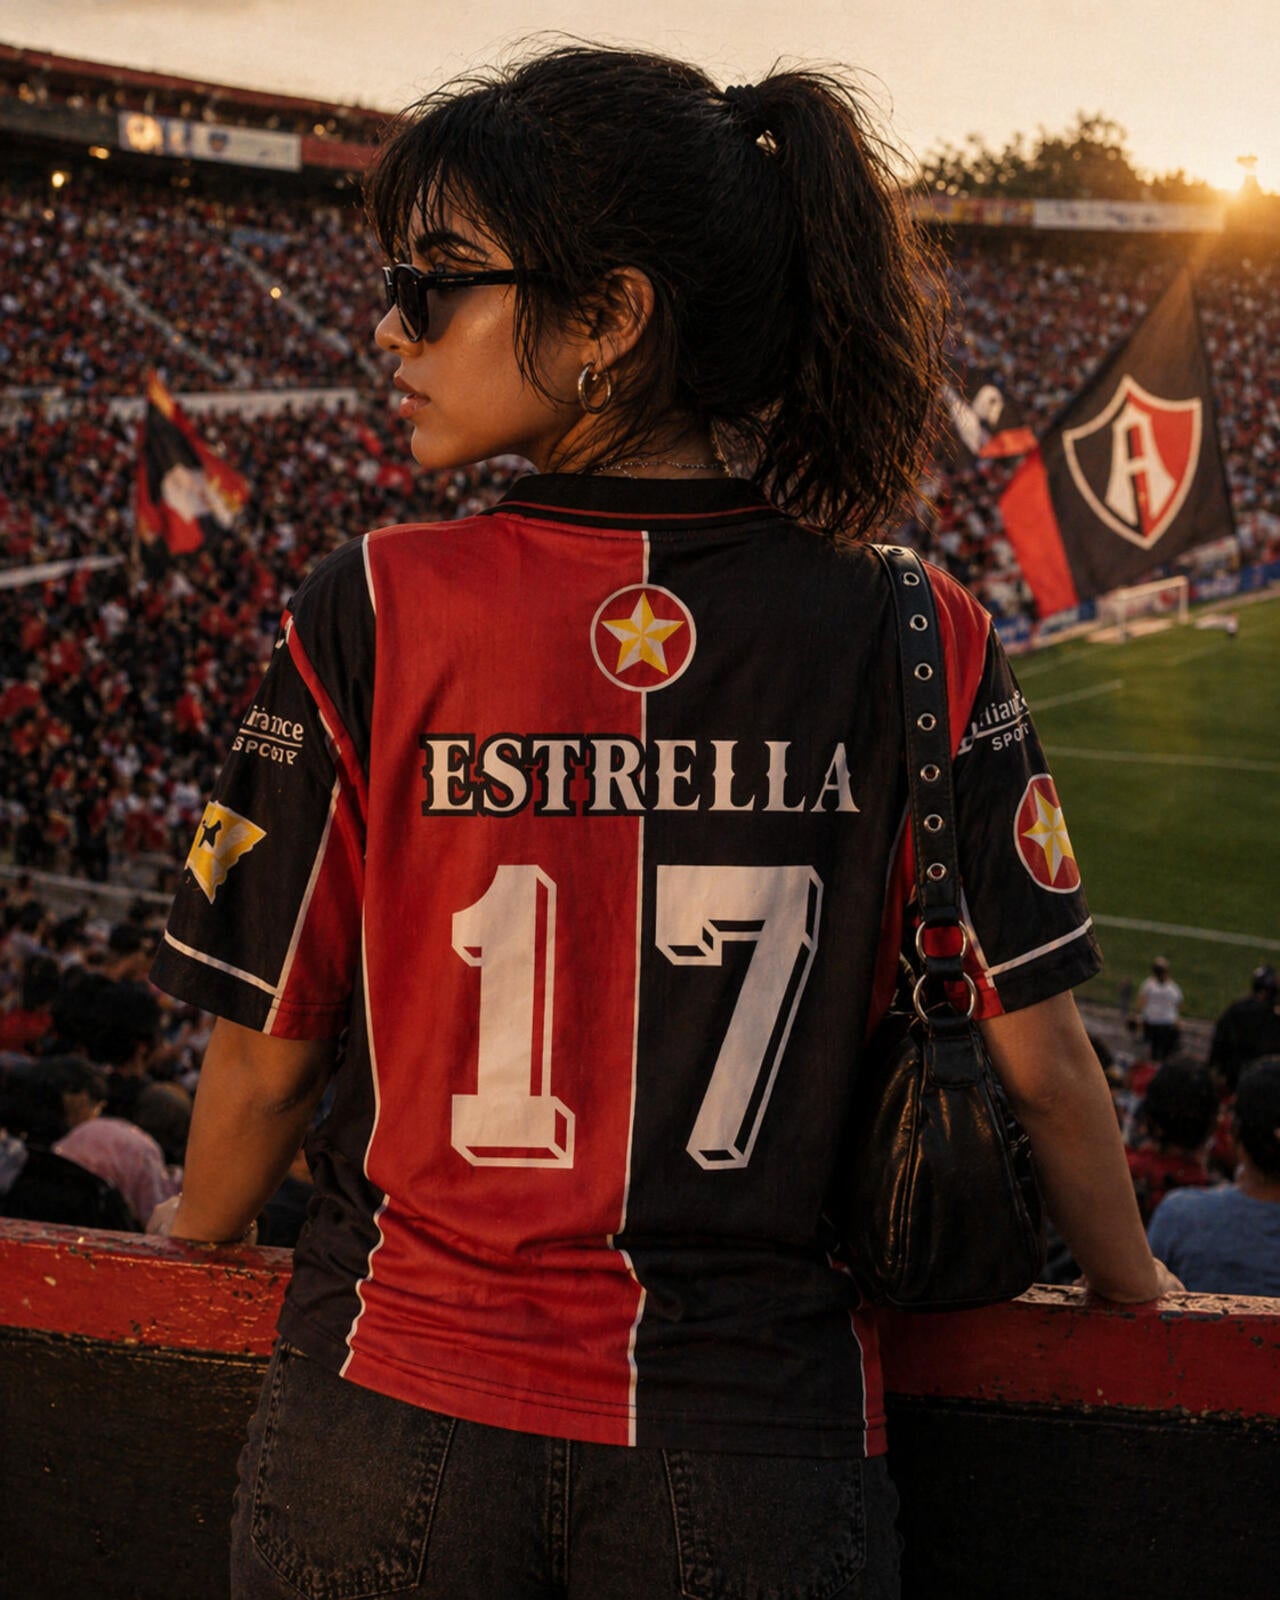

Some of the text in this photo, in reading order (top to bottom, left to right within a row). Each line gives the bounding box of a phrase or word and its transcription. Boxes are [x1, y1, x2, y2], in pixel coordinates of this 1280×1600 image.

[1105, 402, 1176, 526] A
[423, 735, 861, 815] ESTRELLA
[450, 864, 824, 1170] 17
